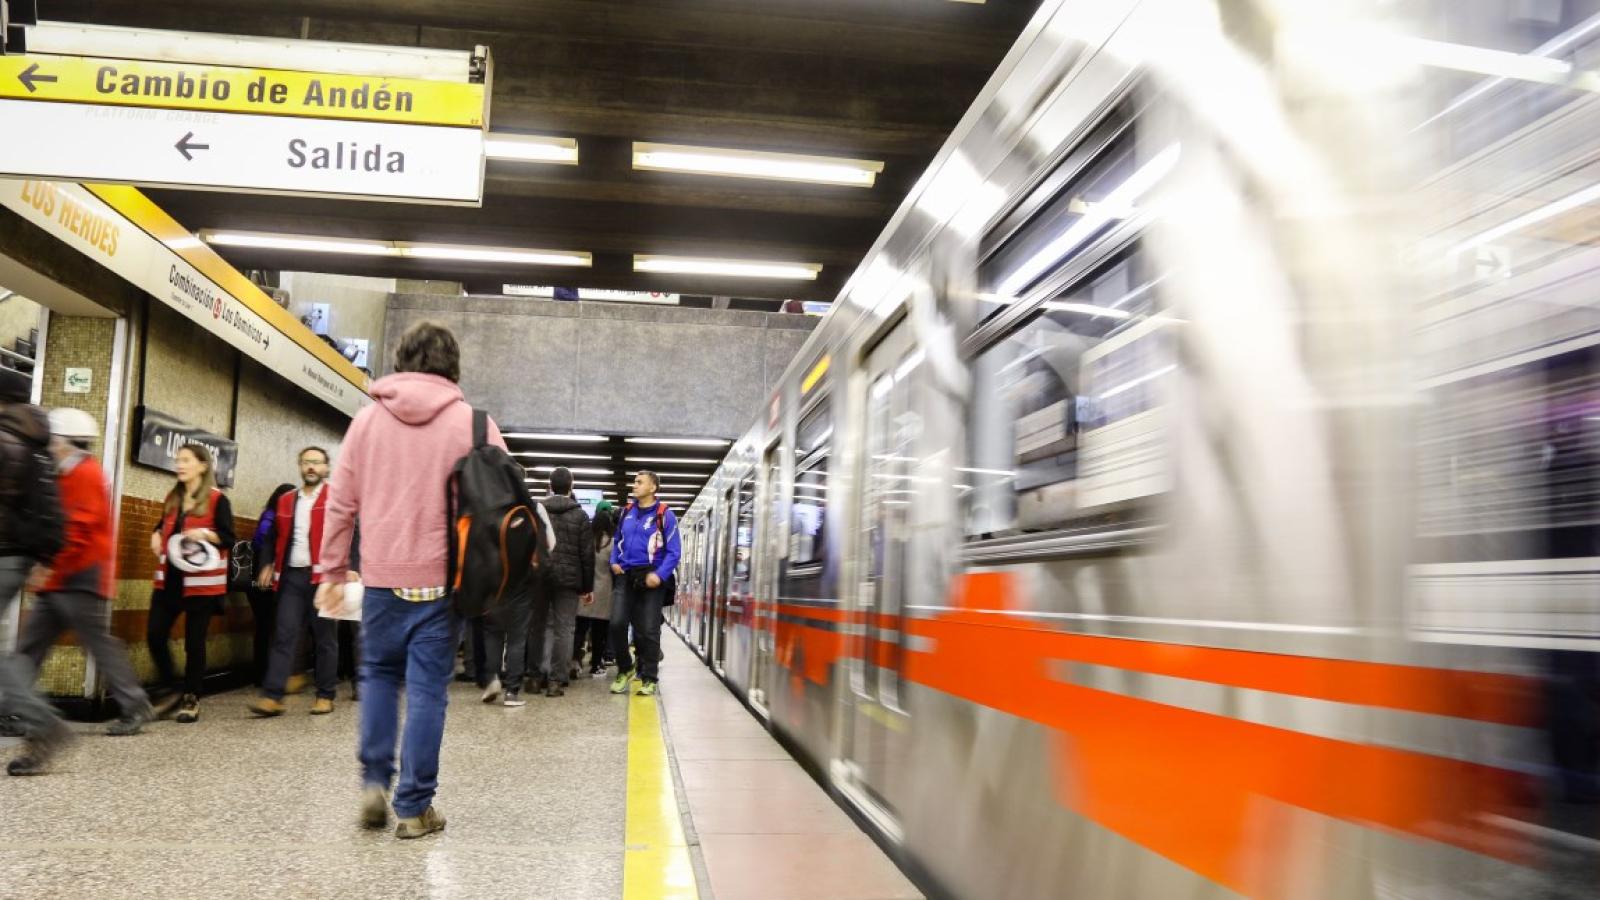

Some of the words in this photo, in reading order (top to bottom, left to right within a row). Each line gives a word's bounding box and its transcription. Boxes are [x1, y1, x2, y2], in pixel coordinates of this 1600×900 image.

[95, 66, 231, 101] Cambio
[247, 76, 288, 104] de
[303, 80, 414, 113] Andén
[287, 138, 405, 173] Salida
[169, 264, 214, 311] Combinación
[222, 302, 234, 324] Los
